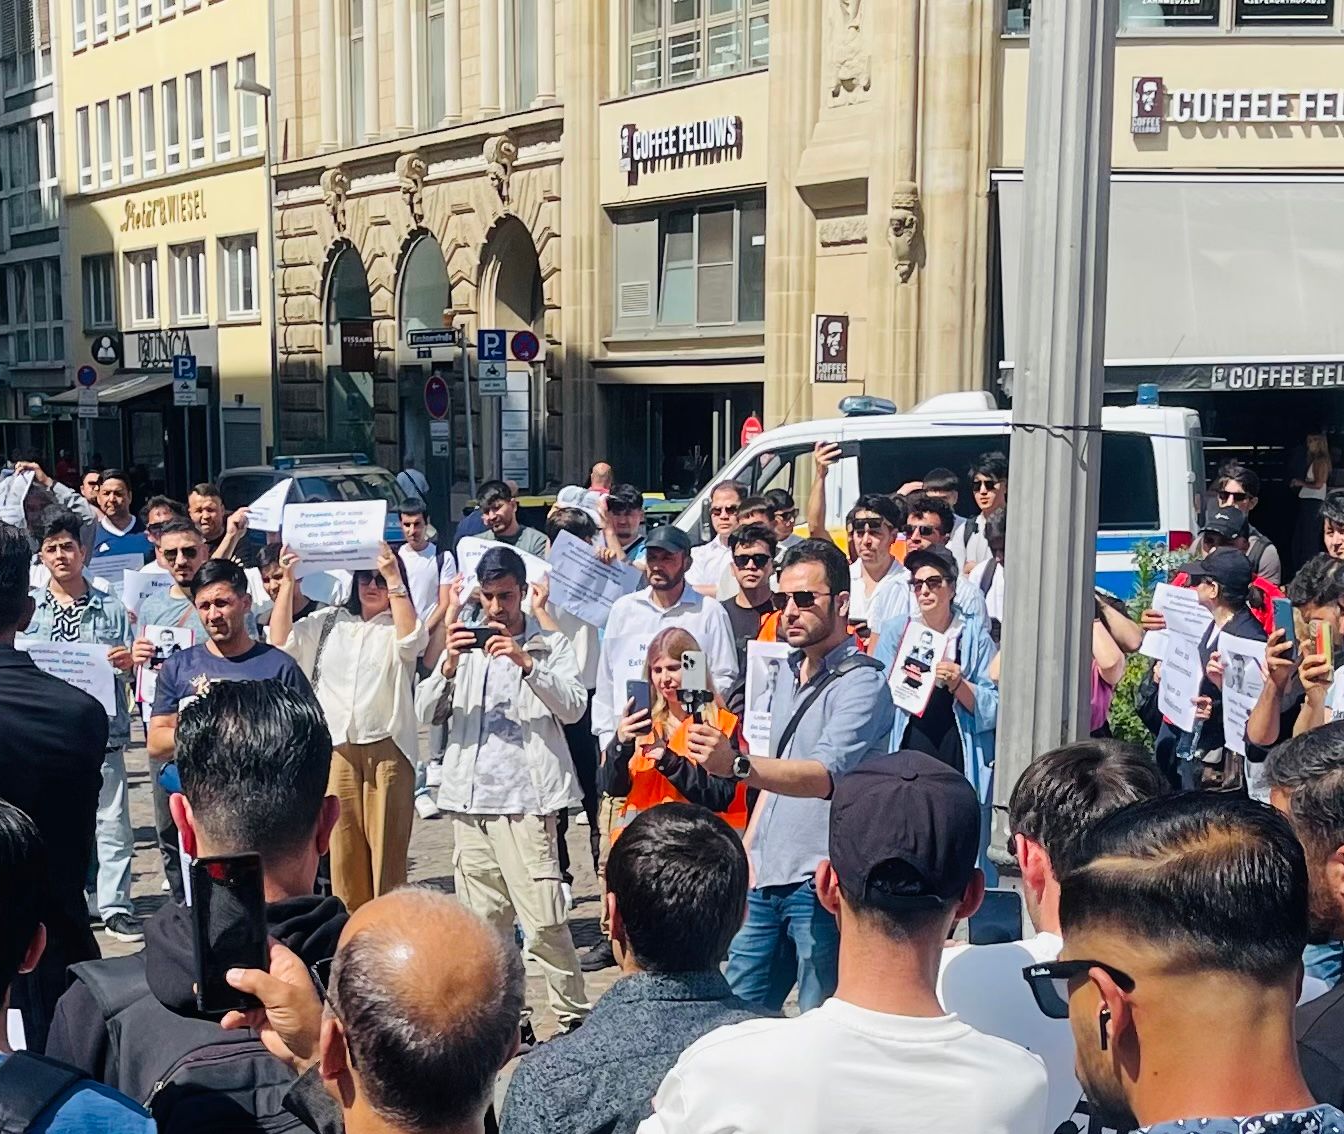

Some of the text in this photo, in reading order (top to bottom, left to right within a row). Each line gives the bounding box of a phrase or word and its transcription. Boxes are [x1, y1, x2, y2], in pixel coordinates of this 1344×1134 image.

[1173, 88, 1289, 123] COFFEE
[633, 115, 737, 161] COFFEE FELLOWS
[167, 188, 206, 224] WIESEL
[484, 334, 500, 357] P
[179, 359, 191, 376] P
[1229, 366, 1306, 388] COFFEE
